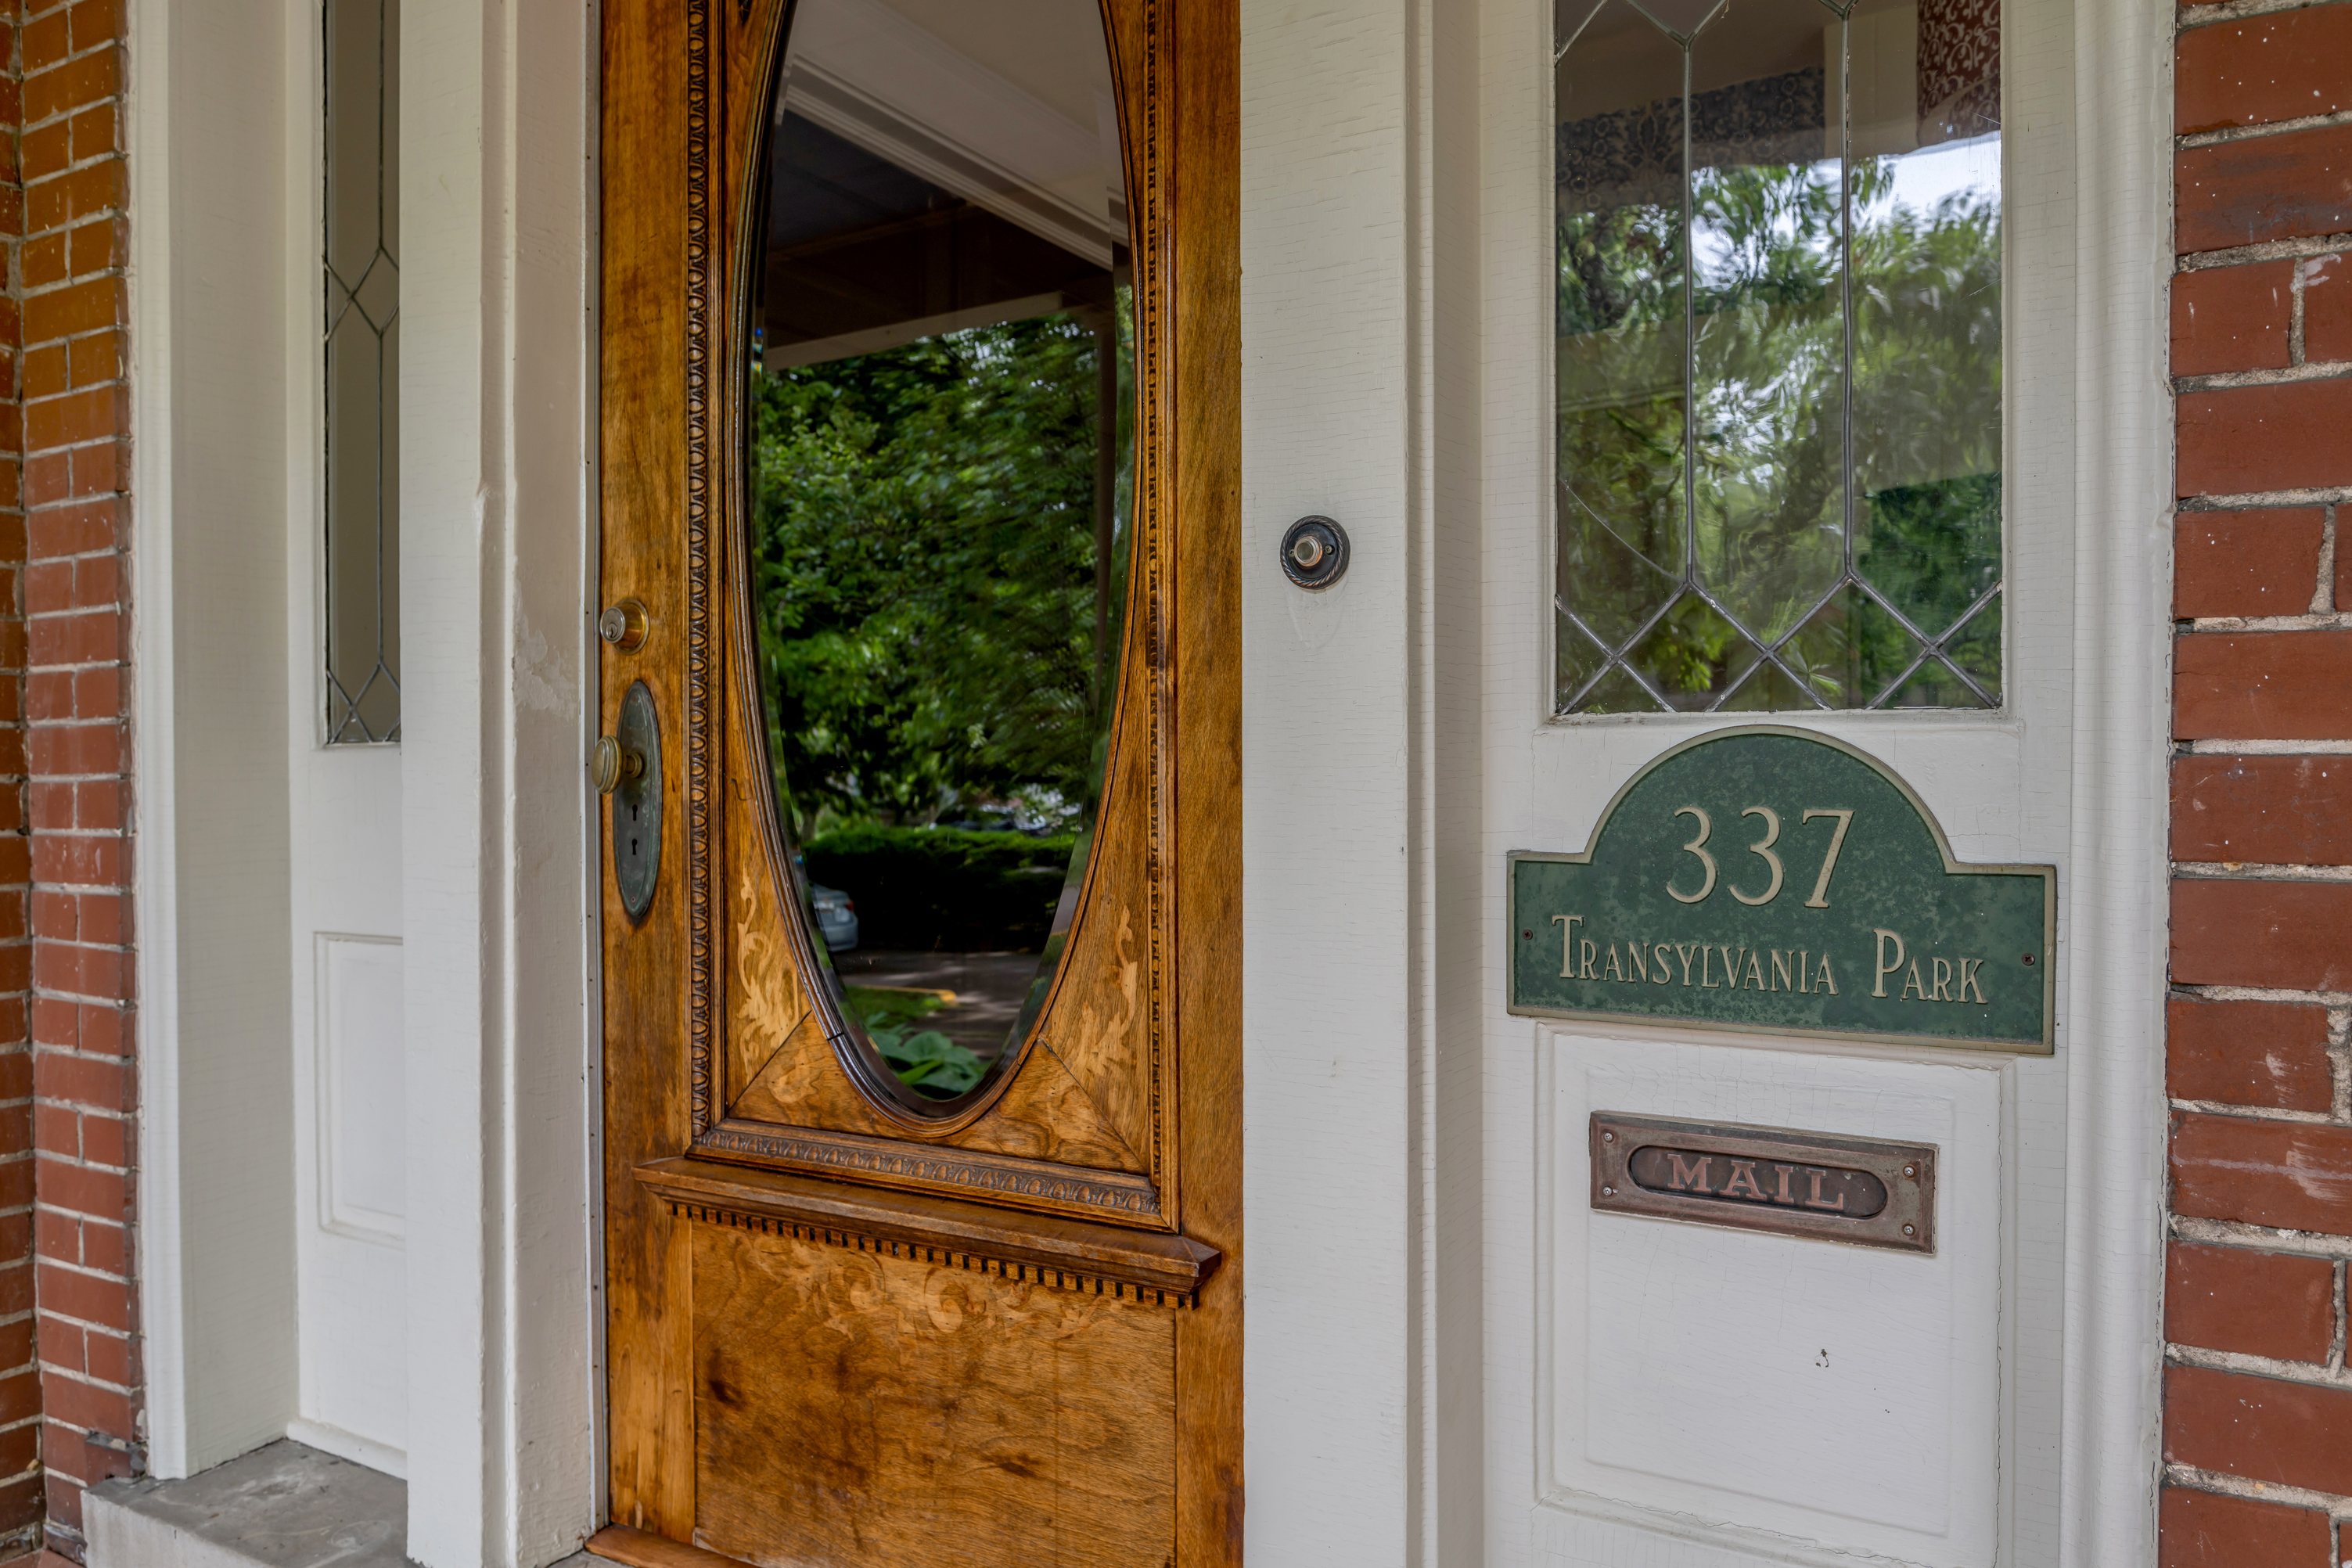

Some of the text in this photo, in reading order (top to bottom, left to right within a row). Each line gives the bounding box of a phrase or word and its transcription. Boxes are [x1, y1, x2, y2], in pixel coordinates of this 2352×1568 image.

[1666, 806, 1854, 908] 337
[1552, 915, 1988, 1005] TRANSYLVANIA PARK
[1667, 1153, 1844, 1210] MAIL
